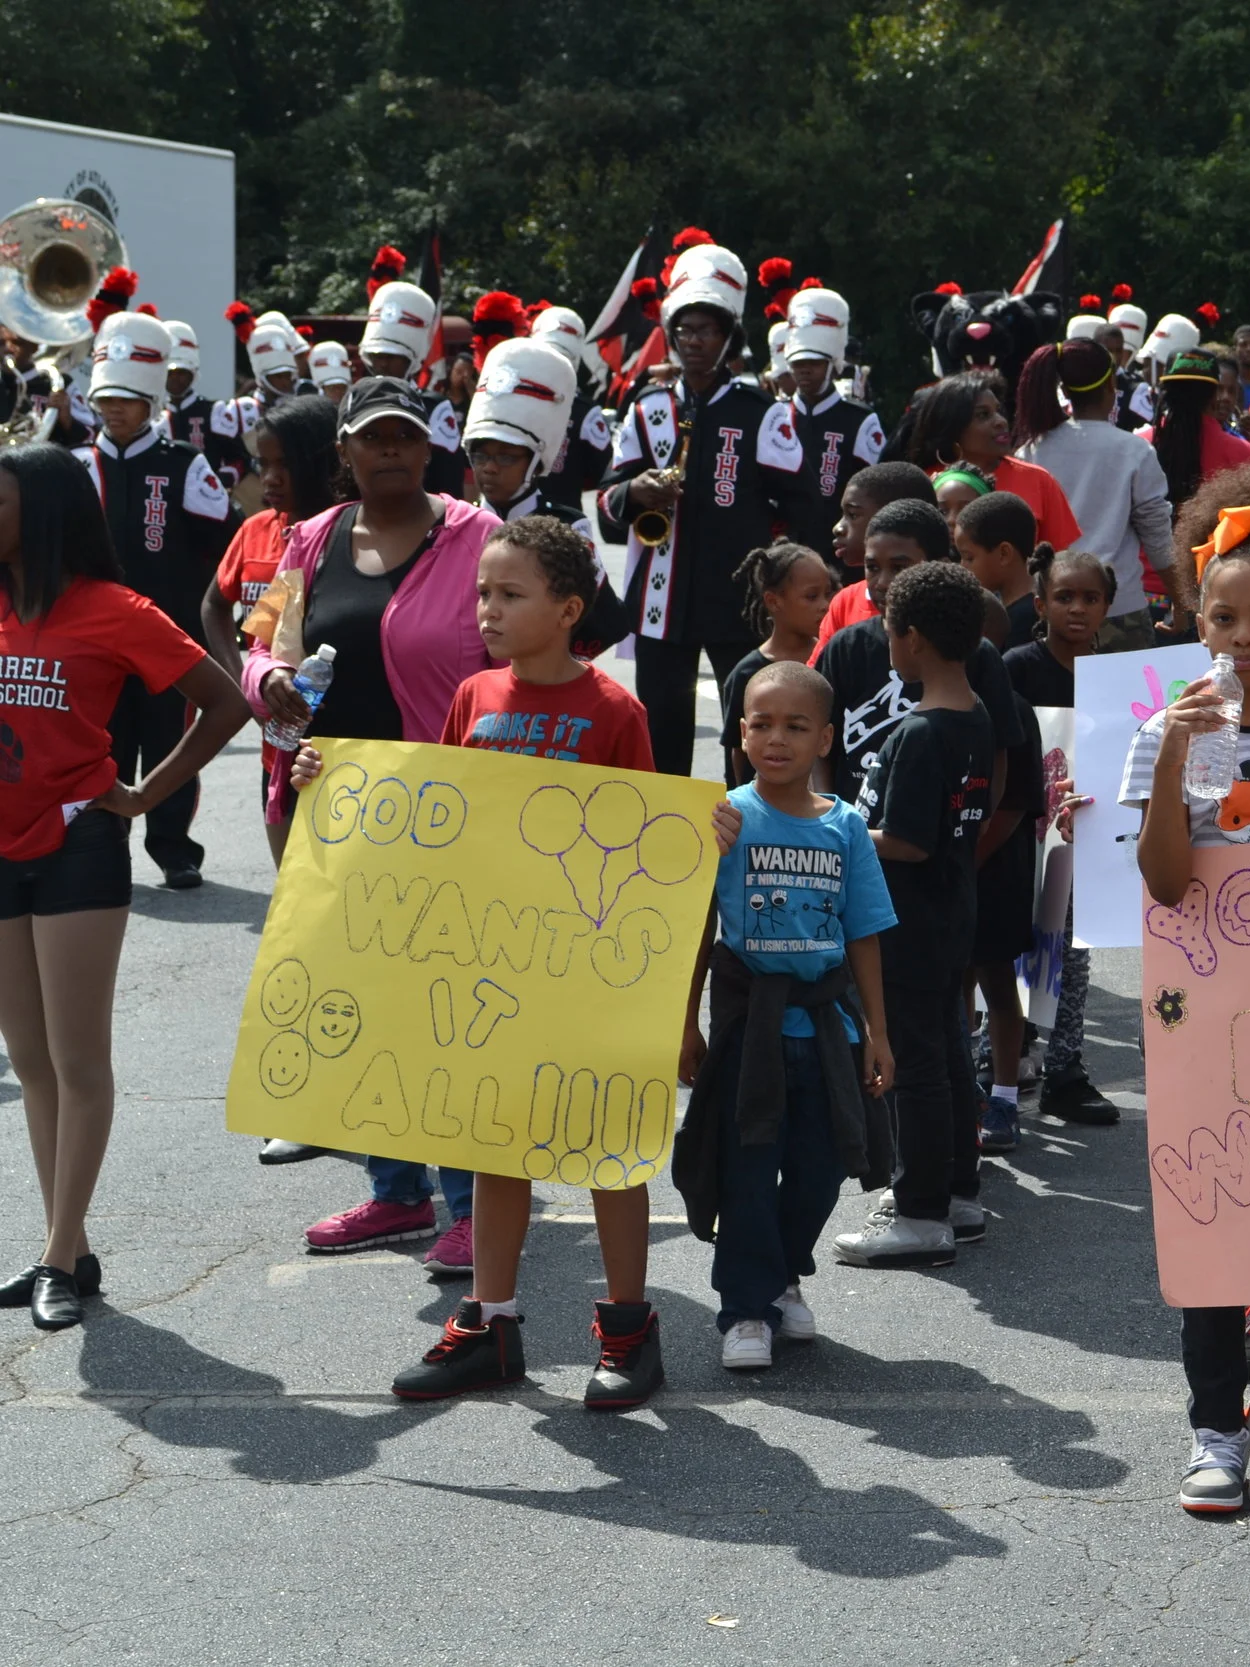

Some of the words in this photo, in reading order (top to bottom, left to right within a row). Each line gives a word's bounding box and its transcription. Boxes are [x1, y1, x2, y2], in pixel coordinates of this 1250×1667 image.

[714, 427, 743, 507] THS
[820, 431, 844, 496] THS
[144, 475, 169, 552] THS
[472, 711, 550, 742] MAKE
[312, 761, 468, 848] GOD
[745, 873, 757, 887] IF
[758, 873, 793, 888] NINJAS
[750, 846, 842, 878] WARNING
[343, 870, 672, 988] WANTS
[429, 977, 520, 1049] IT
